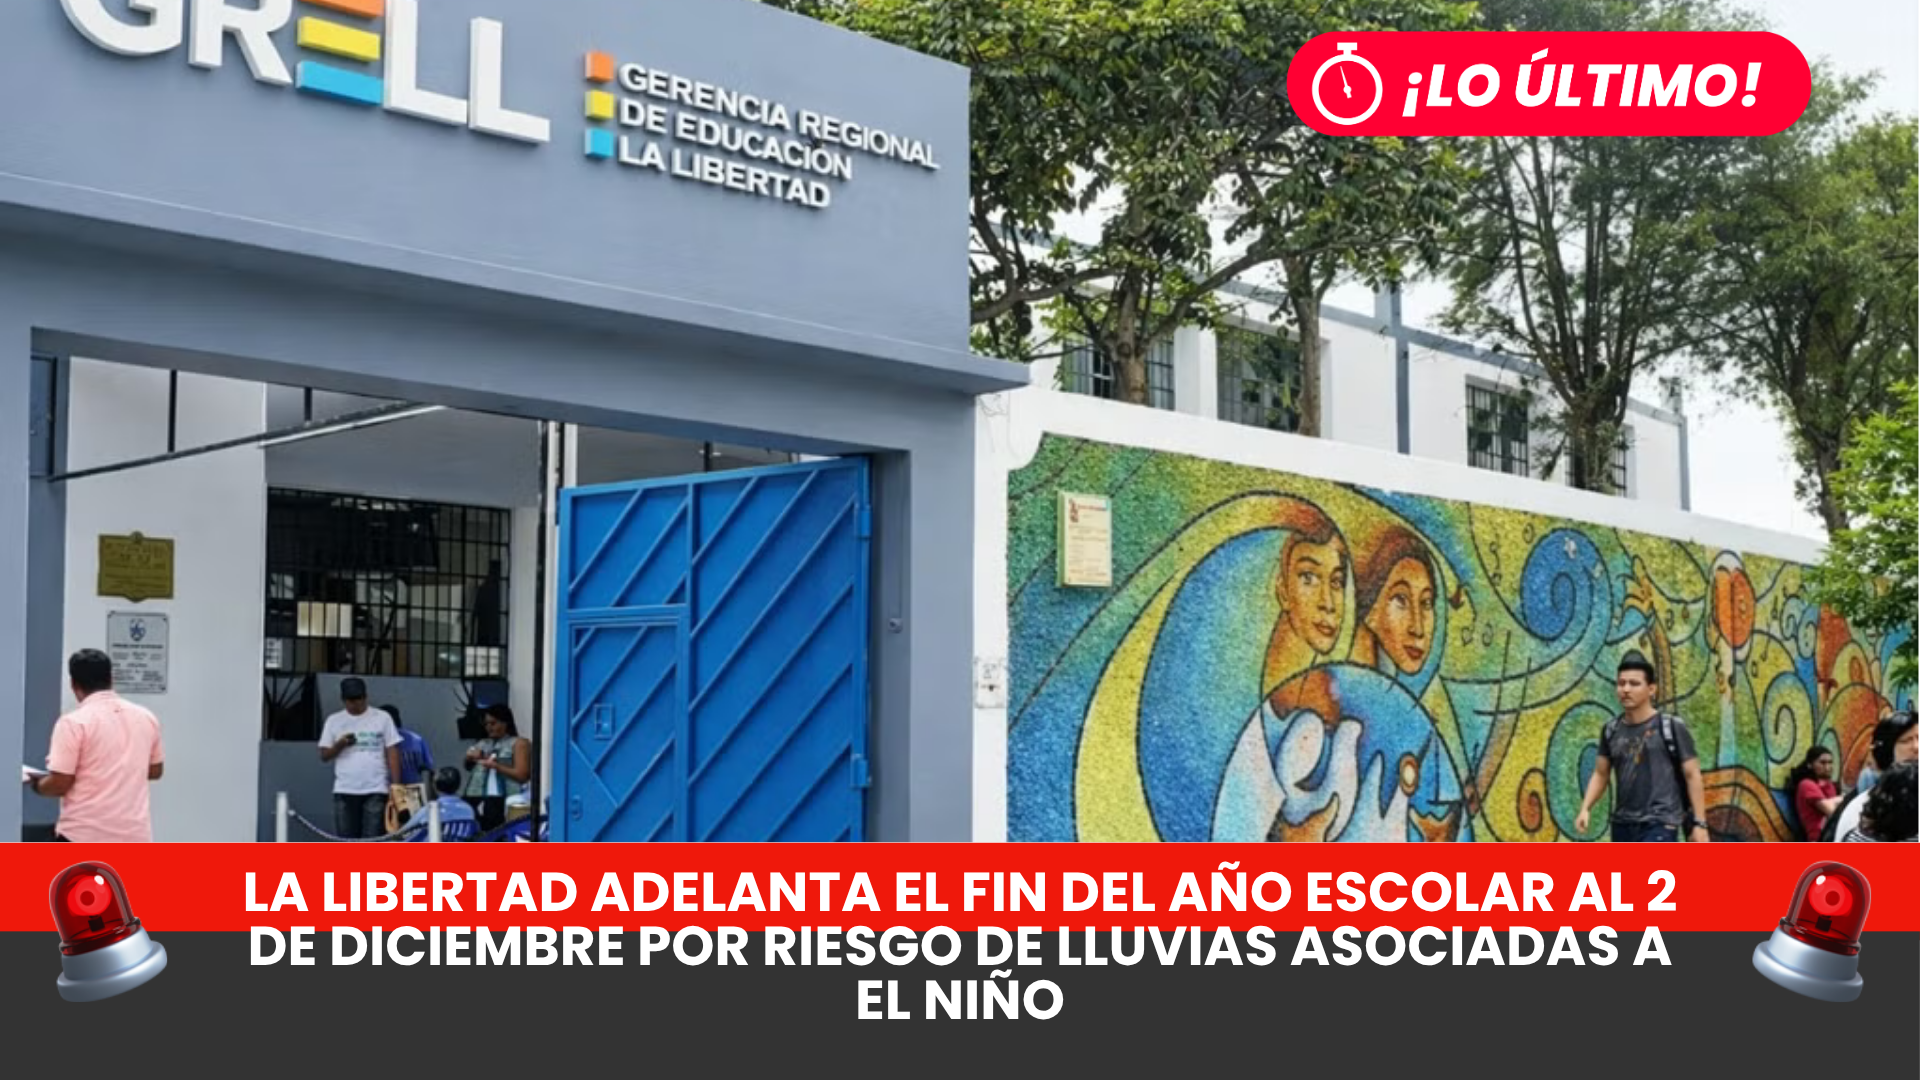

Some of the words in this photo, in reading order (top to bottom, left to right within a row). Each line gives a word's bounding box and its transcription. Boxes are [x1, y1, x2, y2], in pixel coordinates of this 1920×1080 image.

[619, 63, 791, 131] GERENCIA
[799, 109, 941, 170] REGIONAL
[620, 97, 668, 134] DE
[618, 135, 667, 171] LA
[671, 148, 831, 208] LIBERTAD
